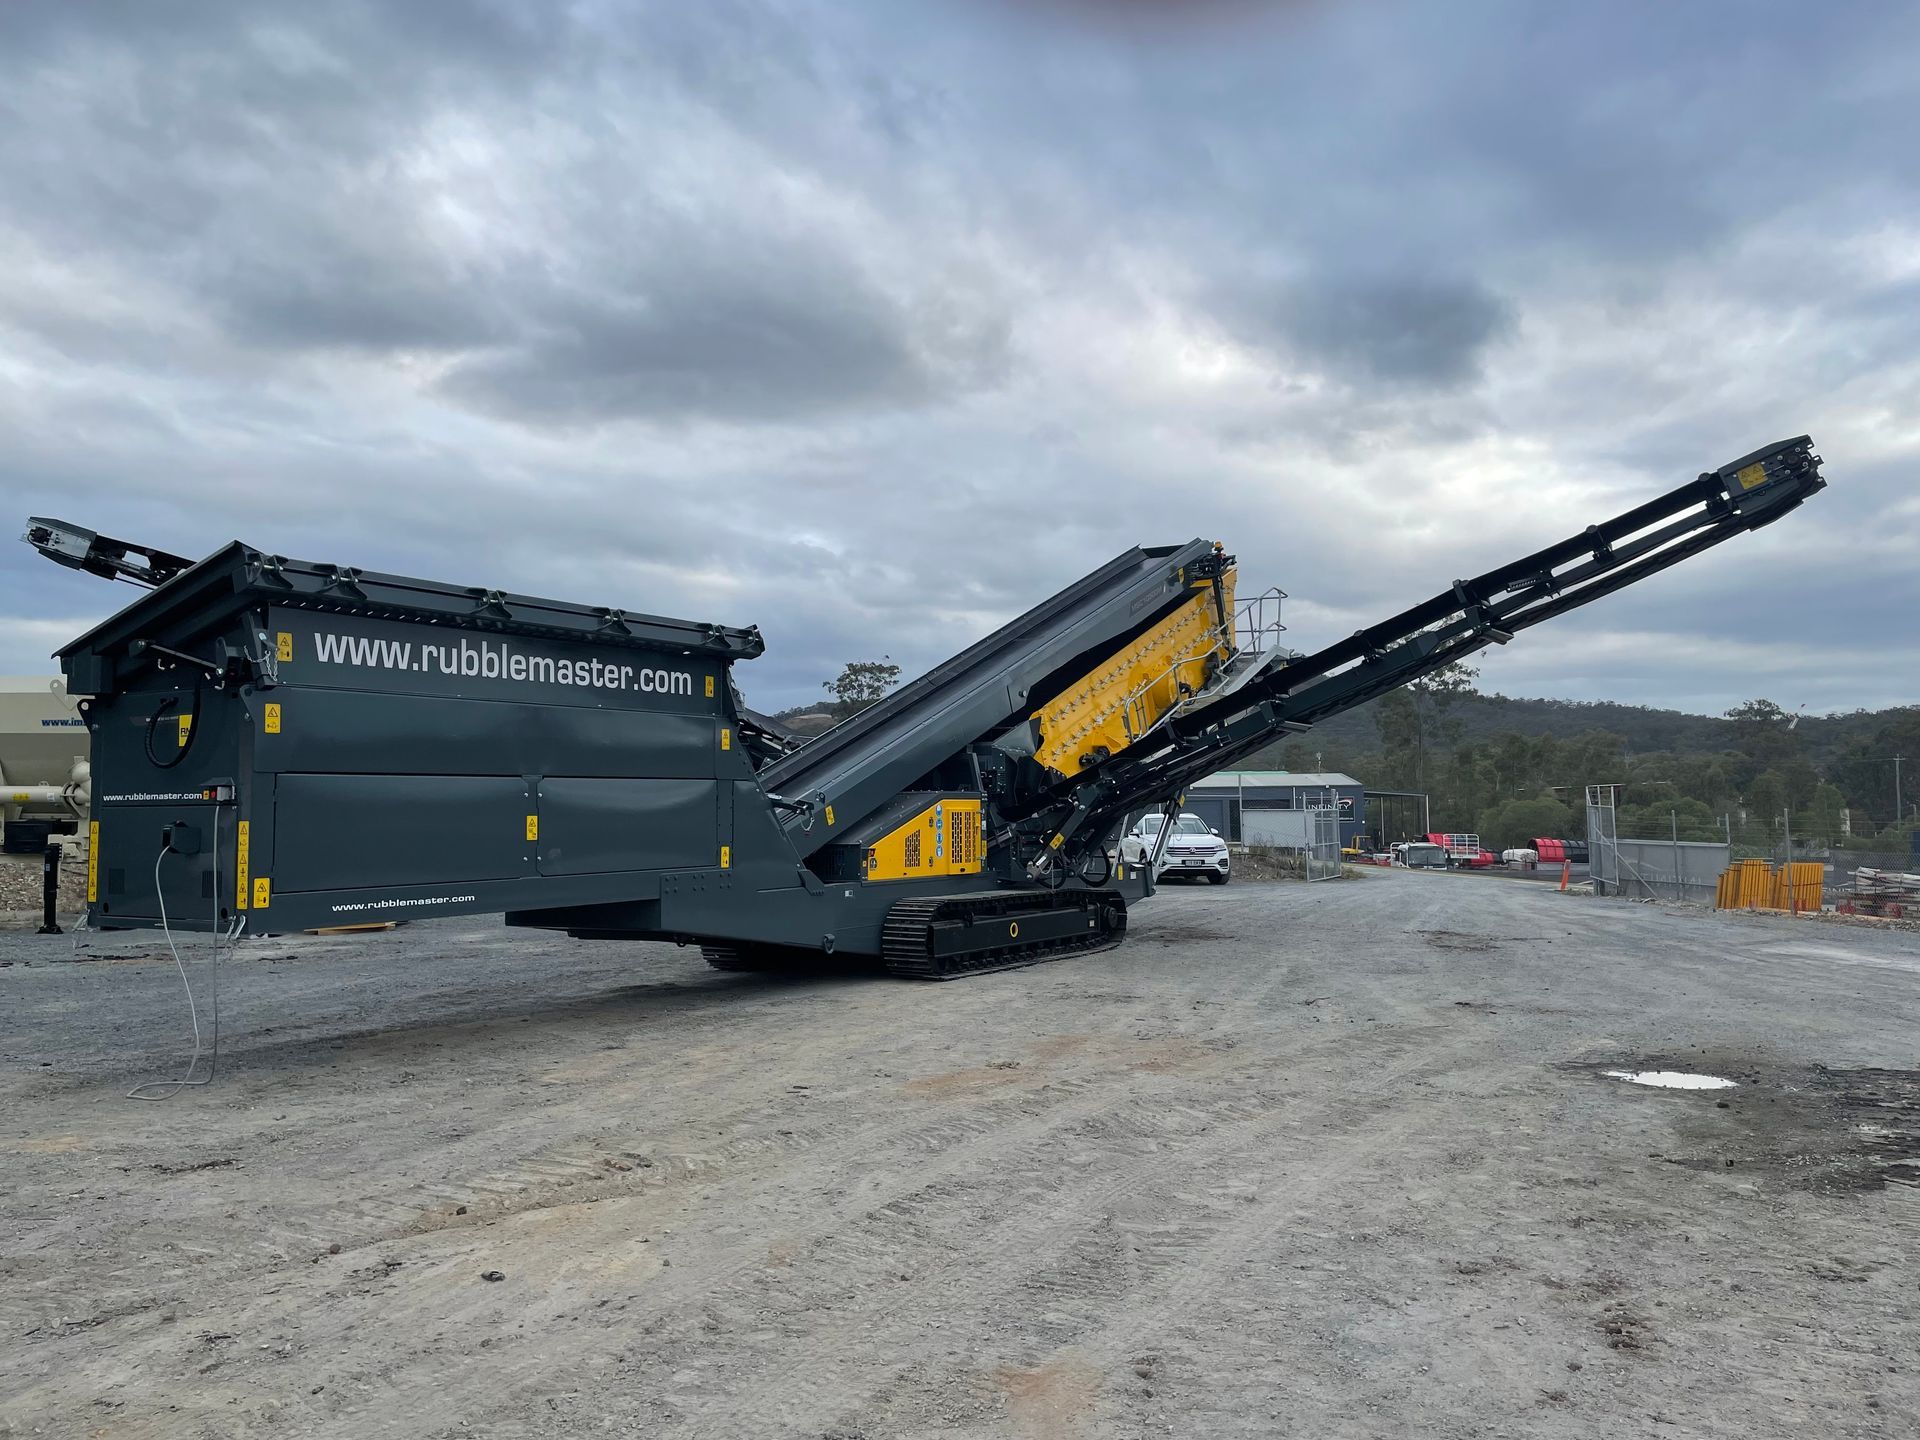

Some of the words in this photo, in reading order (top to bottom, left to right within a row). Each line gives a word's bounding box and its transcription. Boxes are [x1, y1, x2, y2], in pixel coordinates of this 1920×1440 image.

[314, 632, 692, 696] www.rubblemaster.com
[41, 717, 86, 727] www.im
[102, 792, 203, 801] www.rubblemaster.com
[331, 895, 476, 912] www.rubblemaster.com
